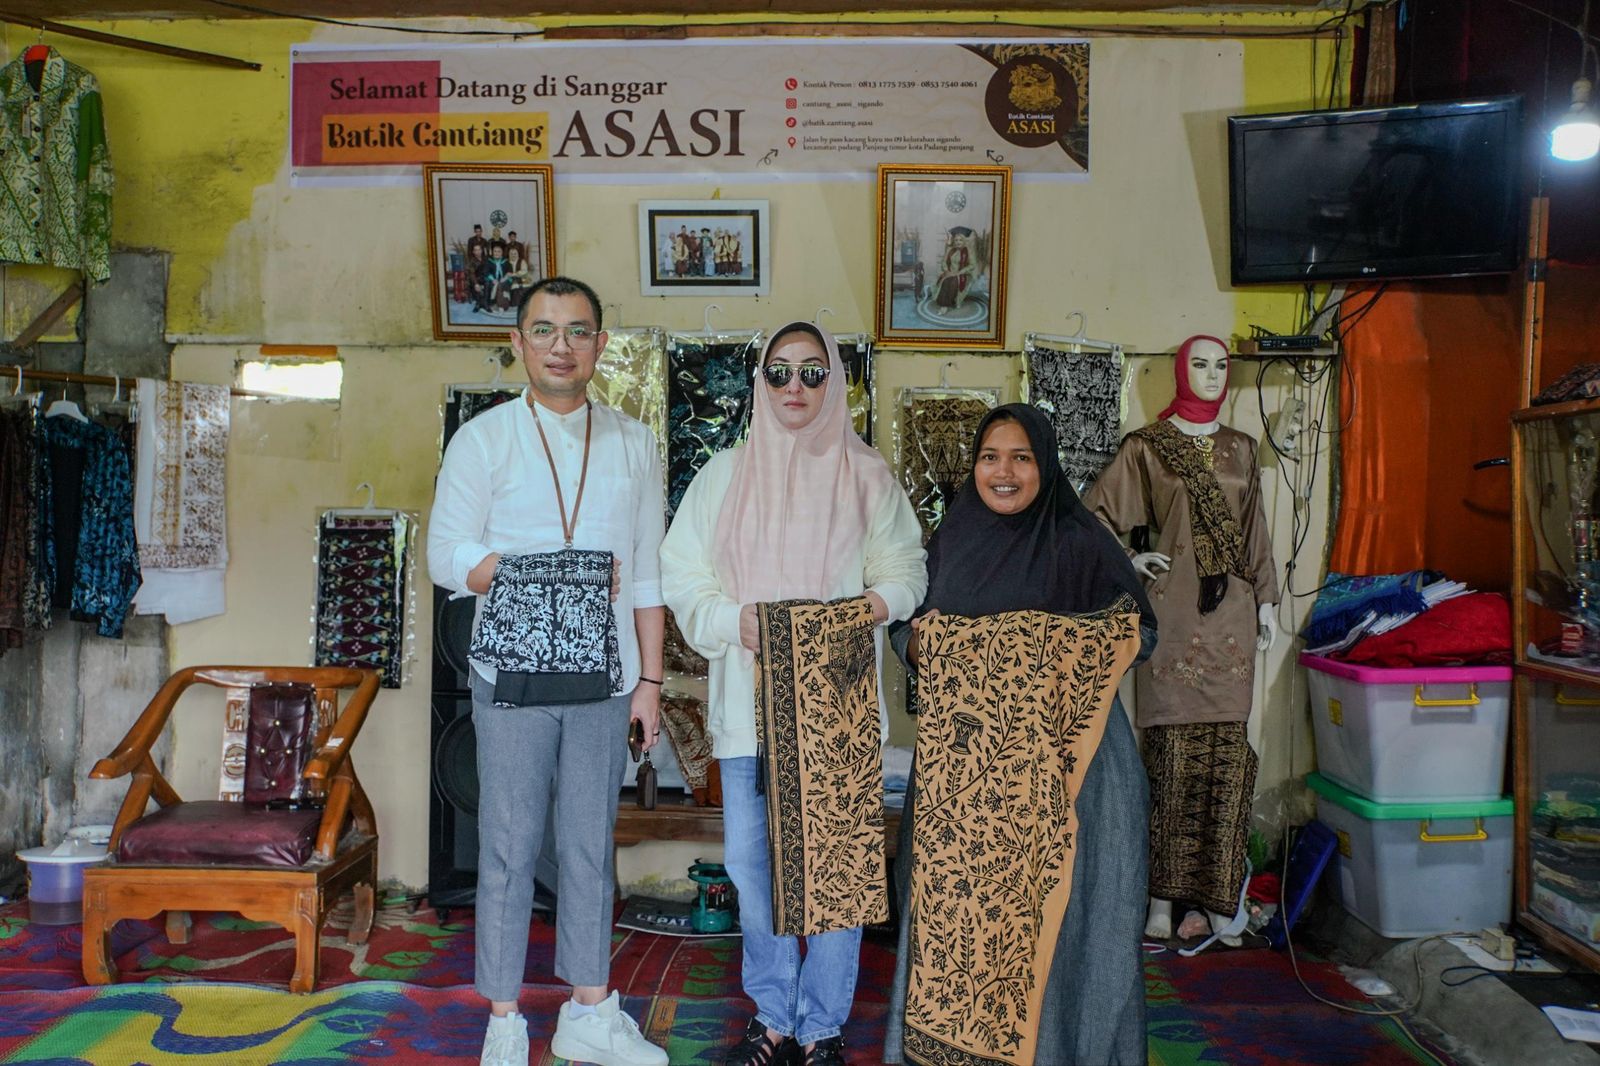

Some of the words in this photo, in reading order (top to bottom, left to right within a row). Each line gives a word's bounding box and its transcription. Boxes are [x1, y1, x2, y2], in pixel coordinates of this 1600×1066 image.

[330, 76, 428, 101] Selamat
[435, 76, 527, 105] Datang
[534, 75, 557, 98] di
[565, 75, 668, 104] Sanggar
[803, 80, 827, 88] Kontak
[829, 80, 852, 88] Person
[858, 81, 877, 89] 0813
[879, 81, 896, 89] 1775
[897, 81, 915, 89] 7539
[920, 81, 939, 89] 0853
[941, 81, 959, 89] 7540
[1007, 120, 1057, 134] ASASI
[327, 121, 406, 149] Batik
[412, 120, 544, 155] Cantiang
[553, 108, 746, 158] ASASI
[803, 135, 819, 144] Jalan
[820, 135, 828, 144] by
[844, 135, 866, 144] kacang
[867, 135, 883, 144] kayu
[803, 143, 836, 151] kecamatan
[838, 143, 862, 152] padang
[862, 143, 888, 152] Panjang
[923, 144, 947, 152] Padang
[948, 144, 975, 152] panjang
